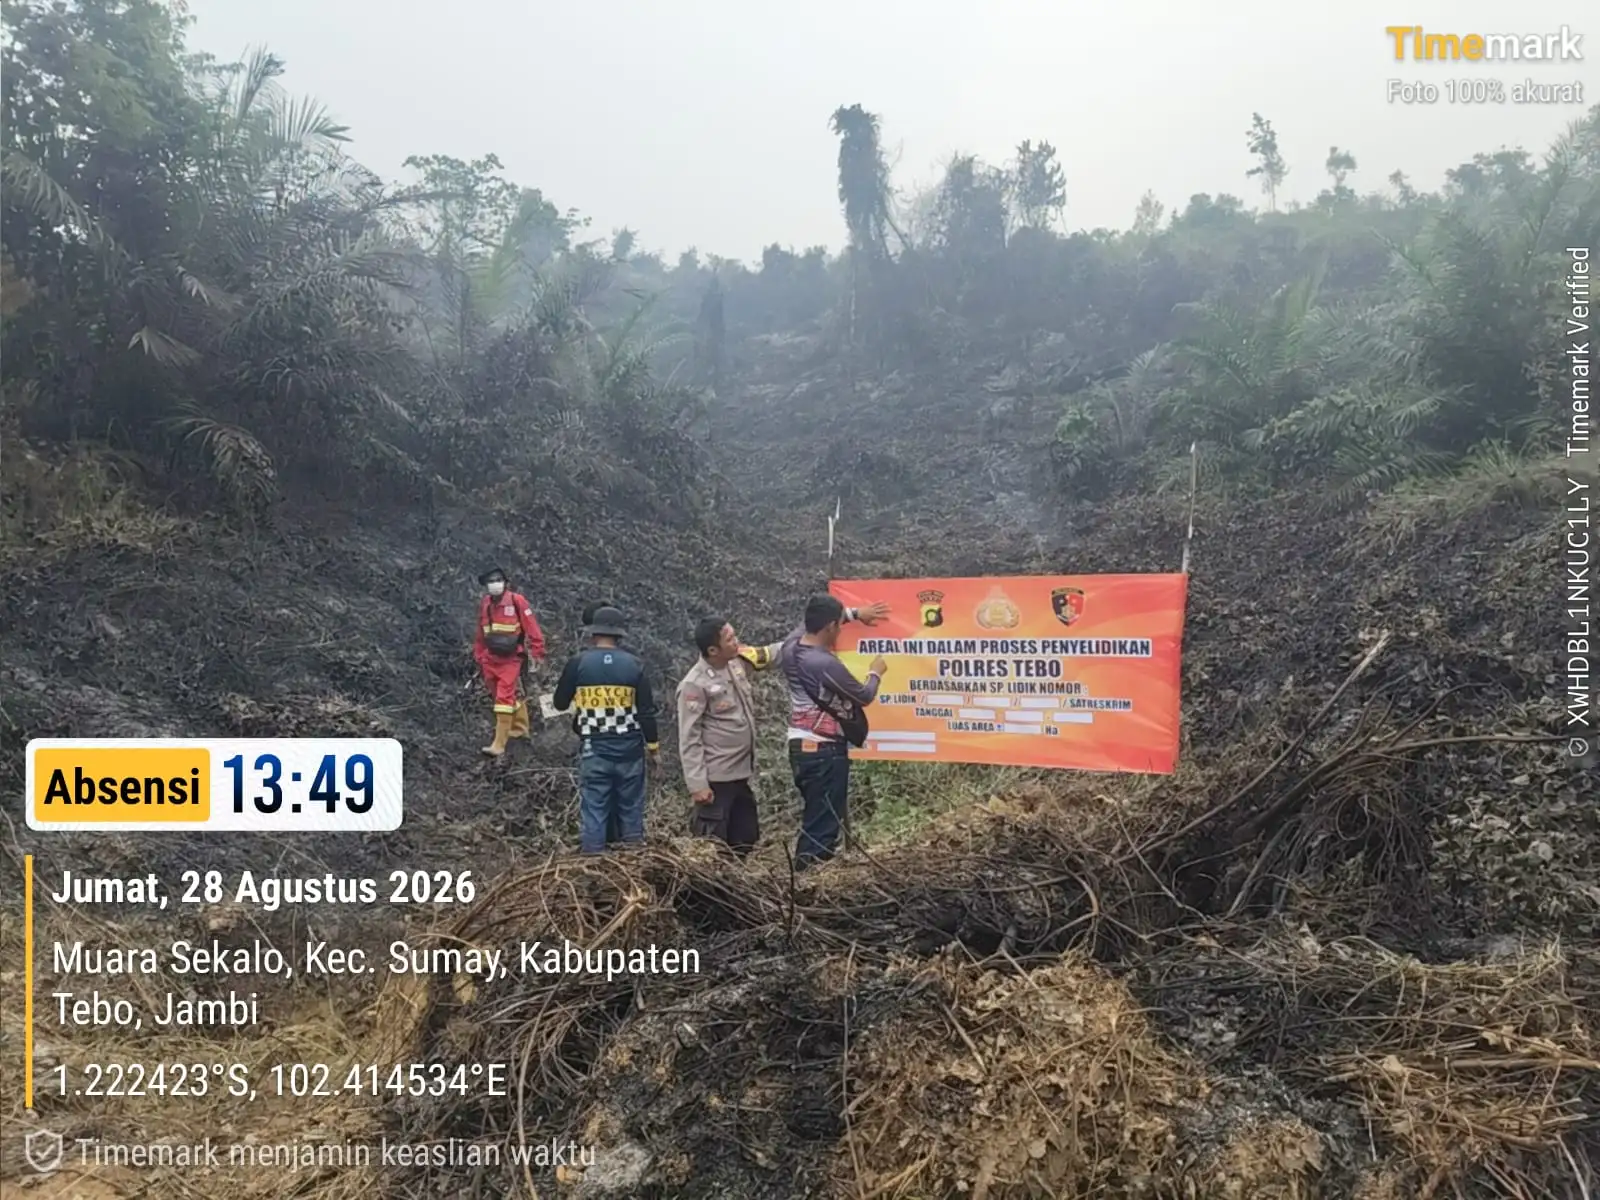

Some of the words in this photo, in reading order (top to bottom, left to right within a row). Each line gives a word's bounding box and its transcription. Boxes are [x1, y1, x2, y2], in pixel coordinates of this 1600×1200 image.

[859, 640, 901, 654] AREAL
[903, 640, 923, 654] INI
[927, 640, 976, 654] DALAM
[980, 640, 1037, 655] PROSES
[1041, 640, 1150, 656] PENYELIDIKAN
[939, 659, 1008, 677] POLRES
[1013, 660, 1061, 678] TEBO
[910, 680, 986, 693] BERDASARKAN
[1007, 682, 1037, 694] LIDIK
[893, 695, 917, 704] LIDIK
[1069, 699, 1132, 709] SATRESKRIM
